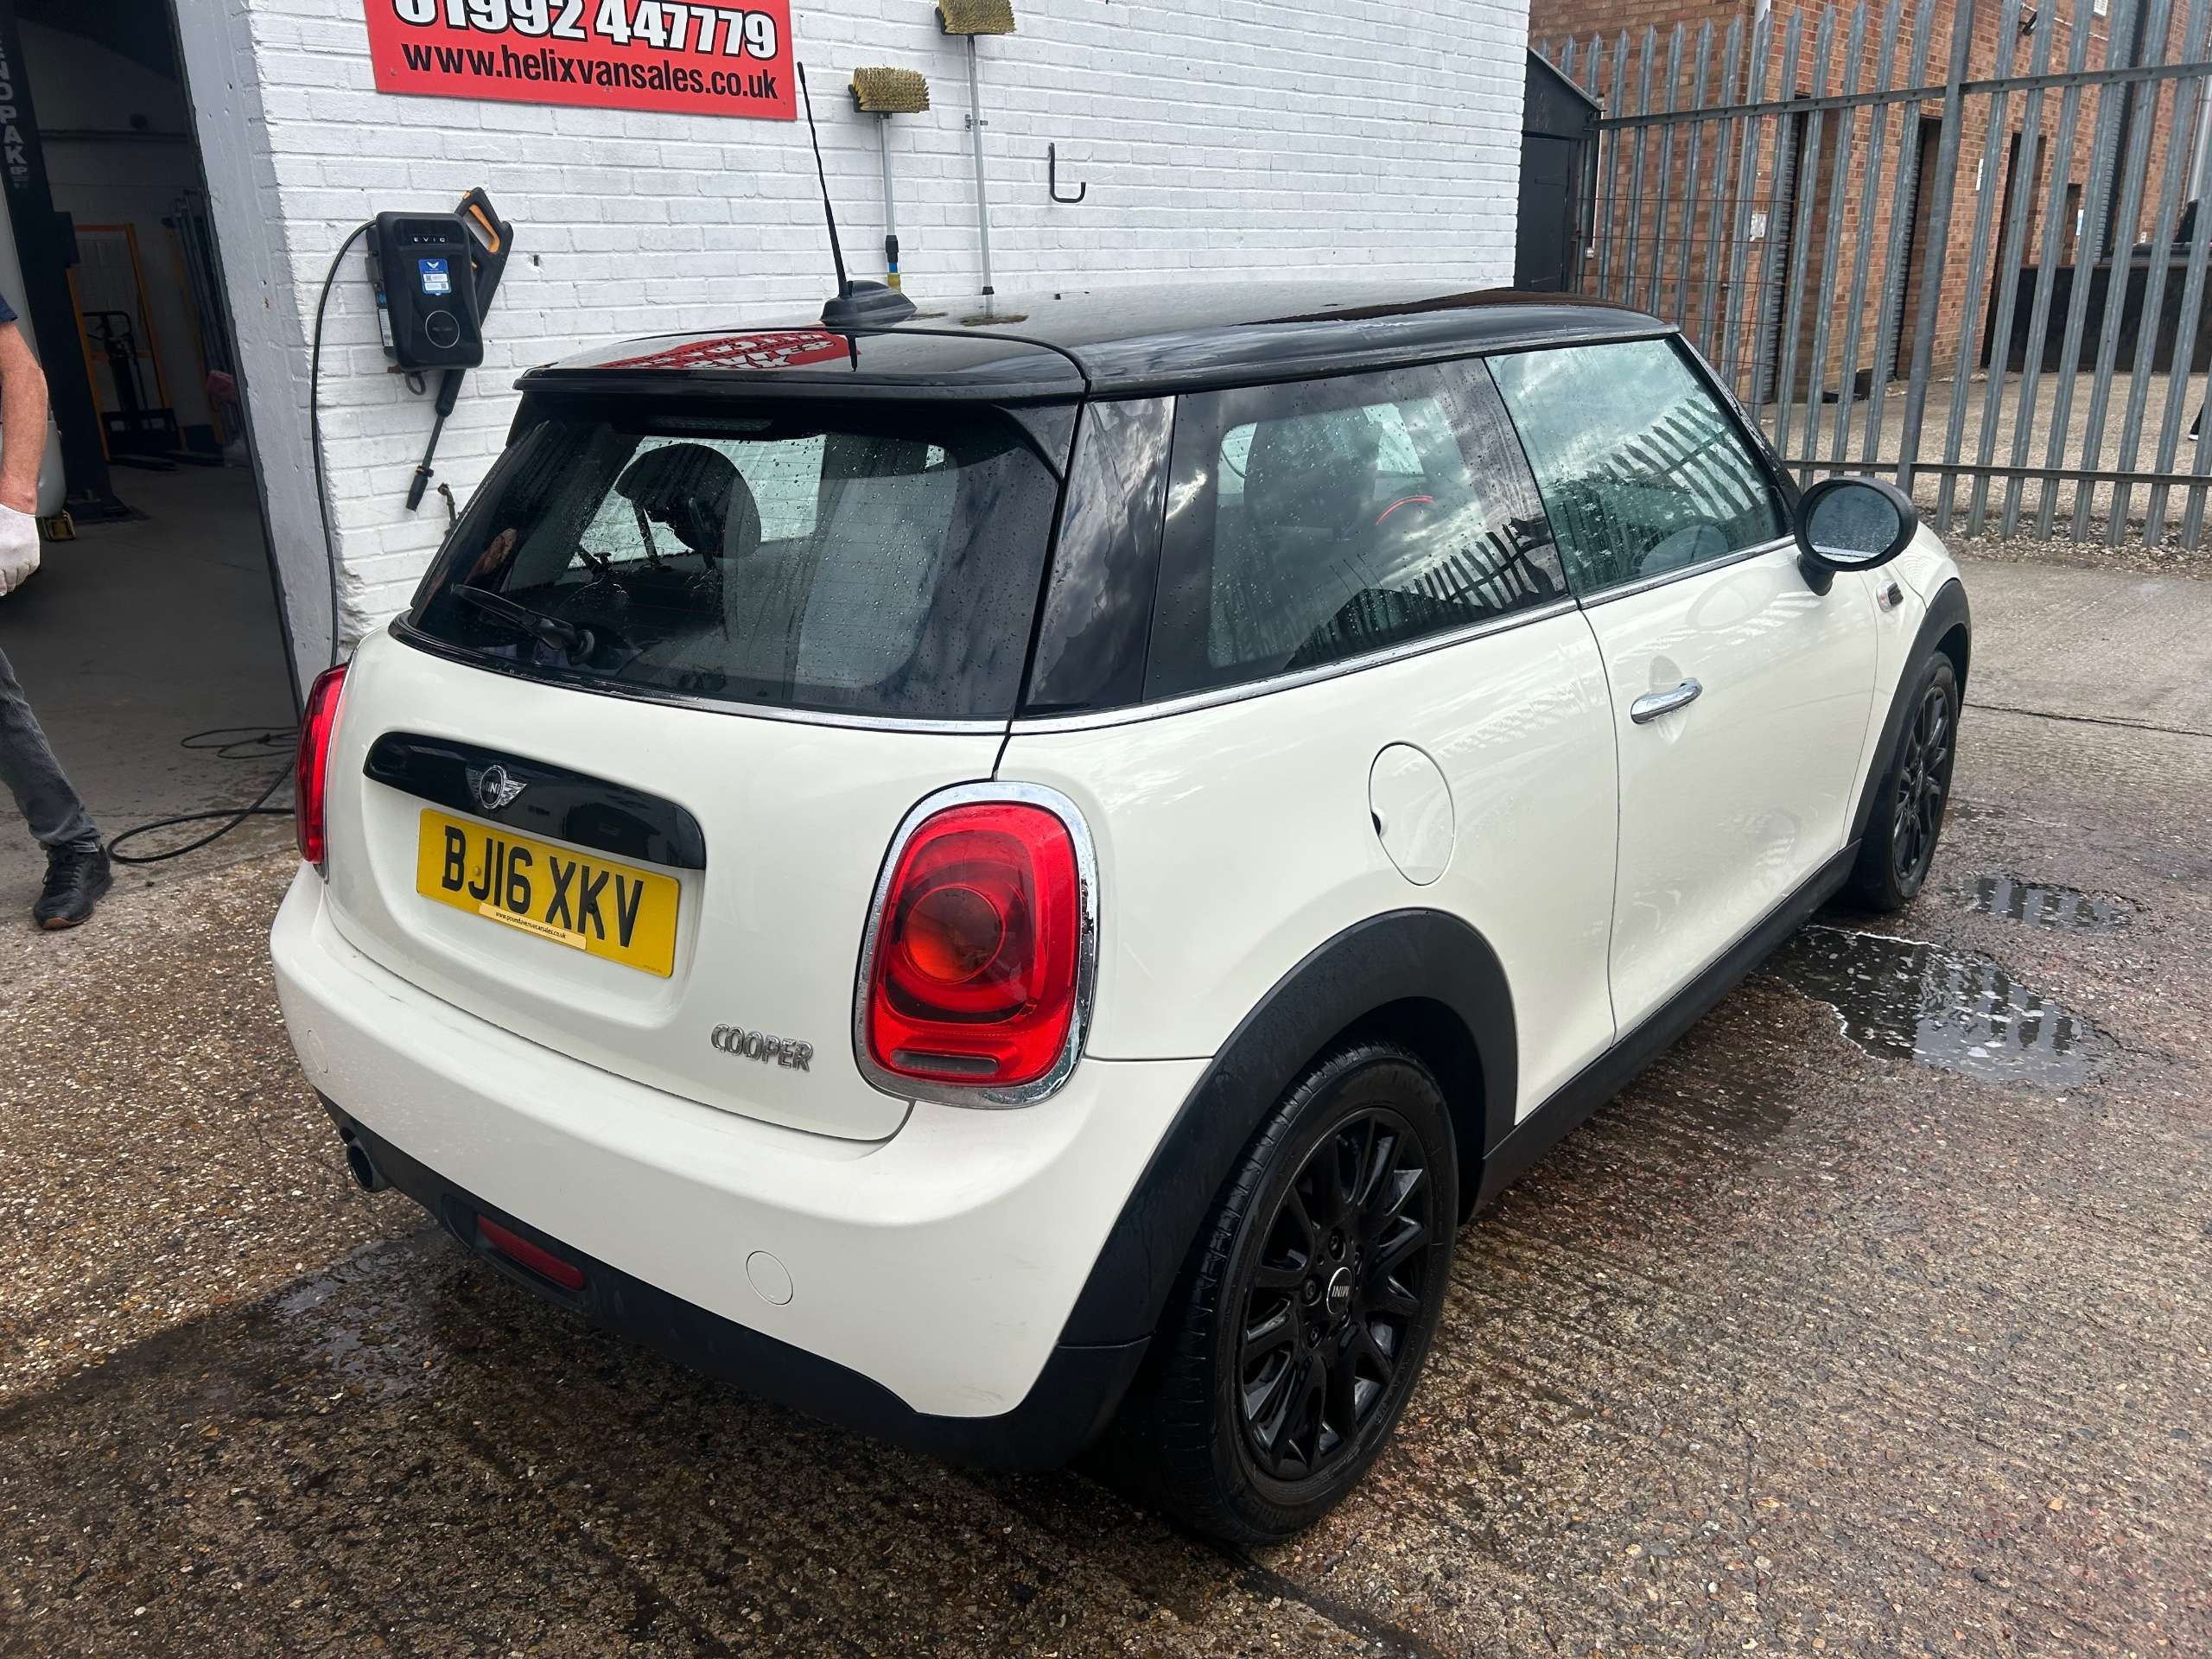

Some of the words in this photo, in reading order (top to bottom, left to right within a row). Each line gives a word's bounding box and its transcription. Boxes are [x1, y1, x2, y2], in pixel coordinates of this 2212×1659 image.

[594, 0, 779, 60] 447779
[401, 43, 778, 99] www.helixvansales.co.uk
[442, 825, 533, 914] BJ16
[545, 855, 645, 948] XKV
[711, 1023, 814, 1072] COOPER
[1332, 1285, 1350, 1297] MINI
